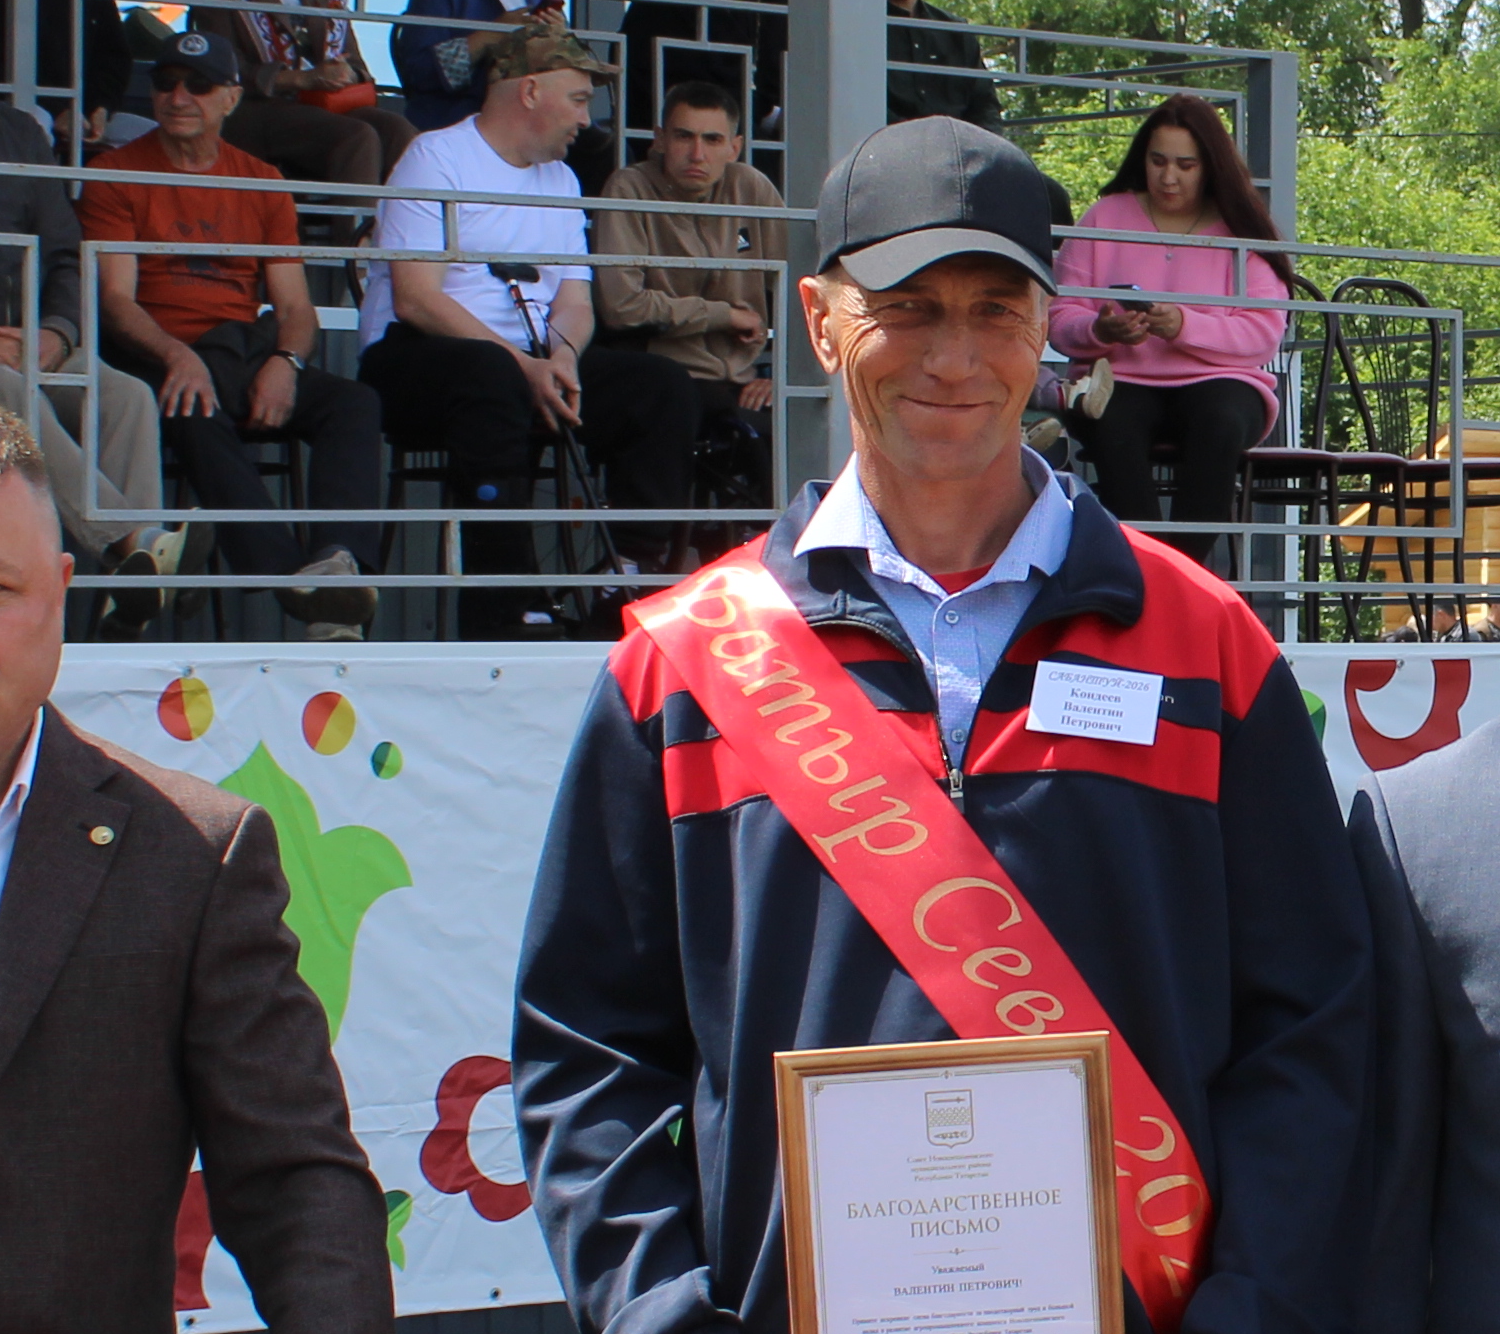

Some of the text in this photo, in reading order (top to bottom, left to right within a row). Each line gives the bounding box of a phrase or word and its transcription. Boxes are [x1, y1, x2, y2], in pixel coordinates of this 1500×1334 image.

[1063, 701, 1124, 718] Валентин
[1060, 715, 1122, 732] Петрович
[912, 876, 1066, 1036] Сев
[846, 1188, 1062, 1220] БЛАГОДАРСТВЕННОЕ
[910, 1216, 1000, 1238] ПИСЬМО
[893, 1278, 1023, 1297] ВАЛЕНТИН ПЕТРОВИЧ!
